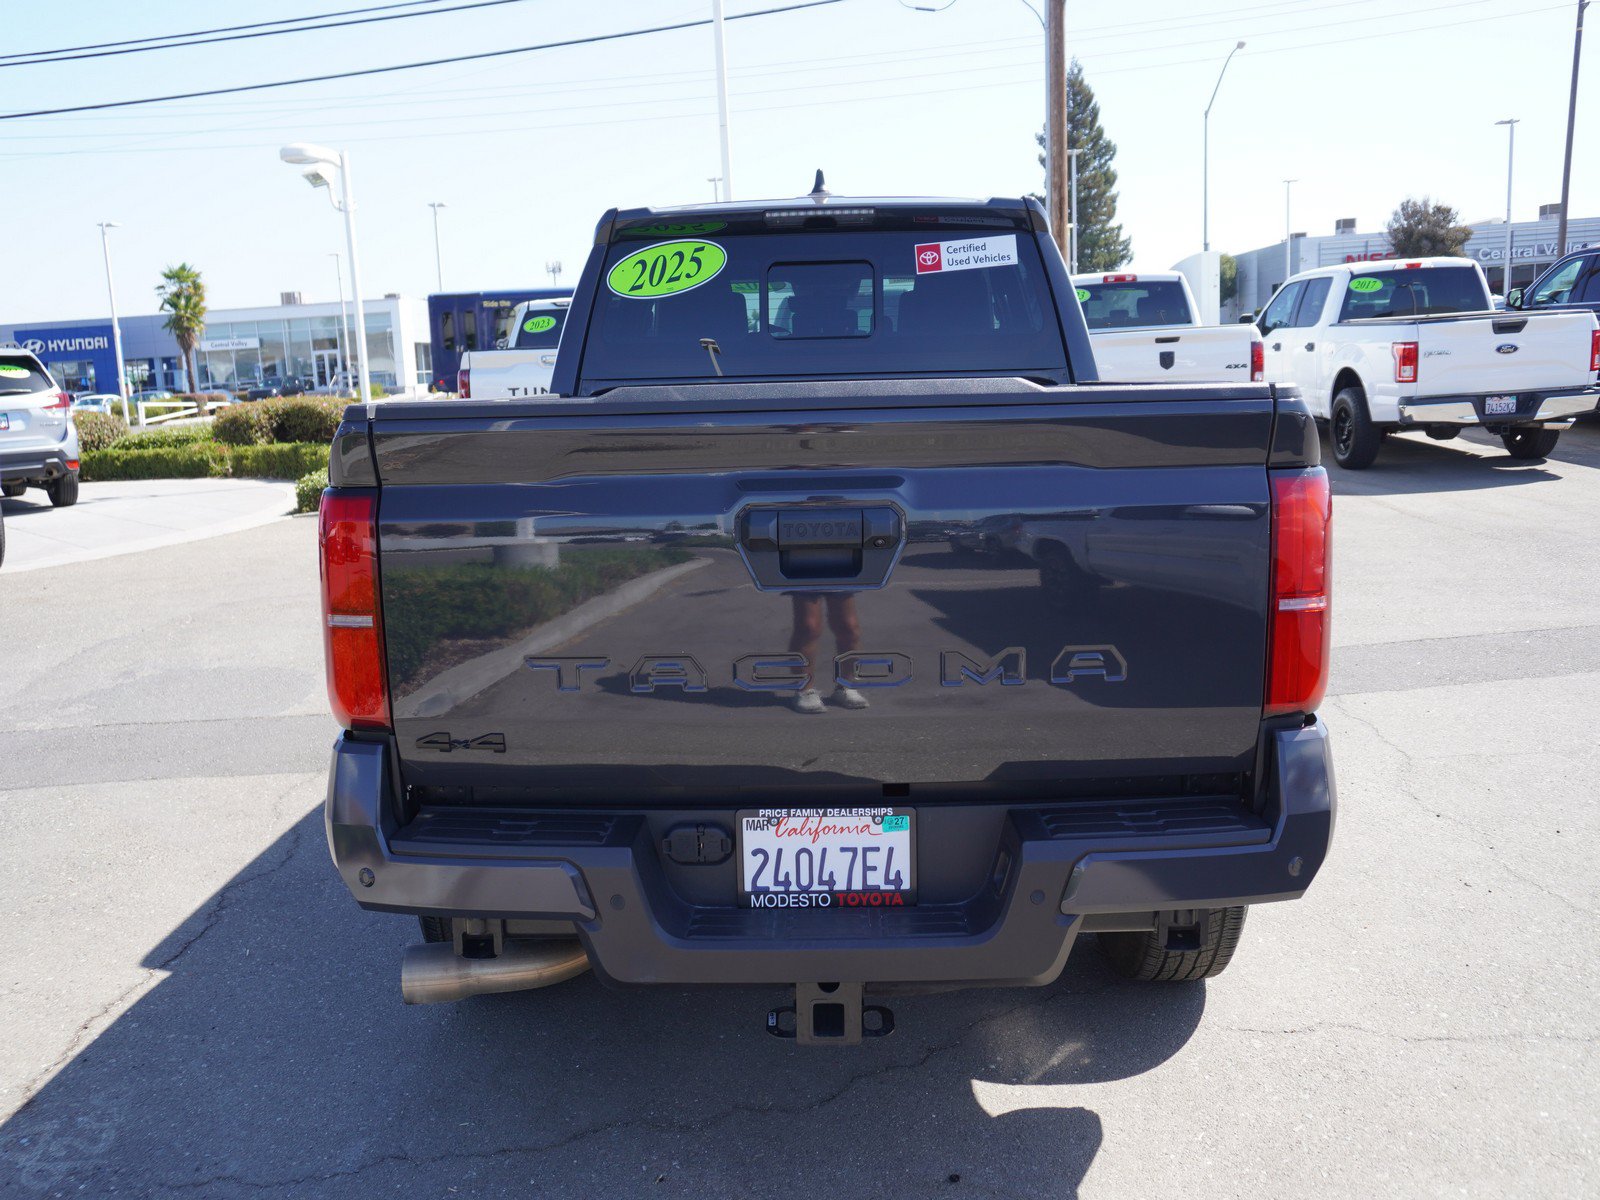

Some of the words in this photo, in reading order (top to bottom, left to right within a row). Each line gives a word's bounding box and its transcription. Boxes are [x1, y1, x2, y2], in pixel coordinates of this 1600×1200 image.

[946, 243, 987, 254] Certified
[1543, 241, 1591, 256] Valle
[947, 256, 970, 266] Used
[973, 253, 1011, 264] Vehicles
[628, 246, 706, 292] 2025
[1355, 280, 1378, 289] 2017
[529, 318, 551, 331] 2023
[47, 336, 109, 352] HYUNDAI
[1500, 344, 1515, 353] Ford
[783, 522, 860, 538] TOYOTA
[524, 644, 1128, 693] TACOMA
[759, 809, 788, 817] PRICE
[790, 808, 824, 817] FAMILY
[827, 807, 894, 817] DEALERSHIPS
[745, 819, 770, 831] MAR
[894, 816, 905, 826] 27
[774, 815, 883, 844] California
[751, 846, 904, 892] 24047E4
[751, 893, 831, 908] MODESTO
[836, 893, 905, 907] TOYOTA
